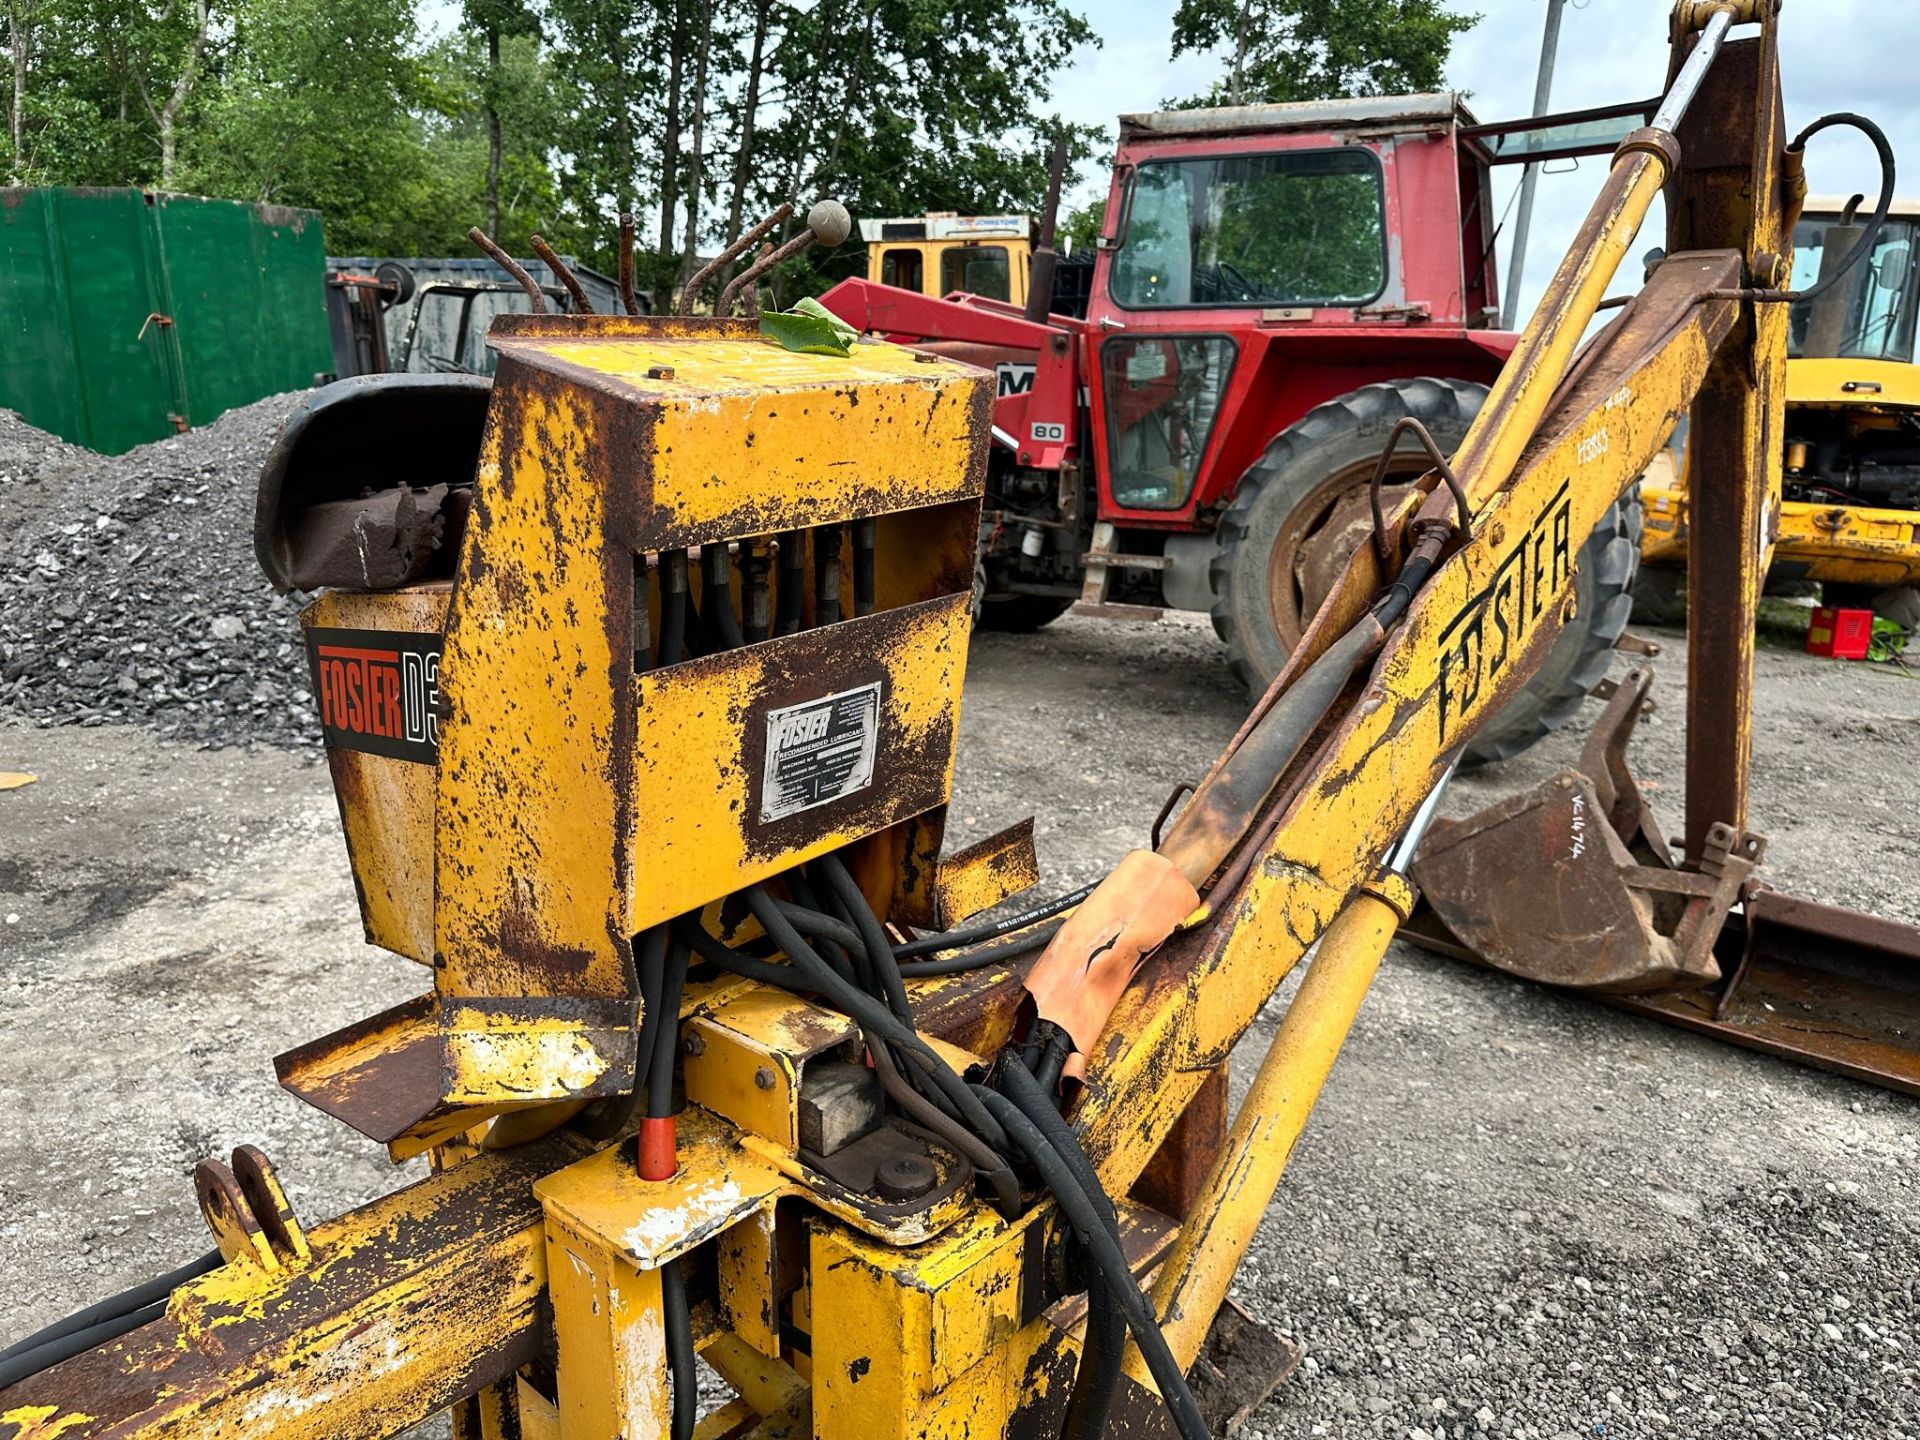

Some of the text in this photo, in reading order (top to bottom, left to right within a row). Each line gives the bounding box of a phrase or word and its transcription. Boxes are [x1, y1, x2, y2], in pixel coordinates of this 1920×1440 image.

[1034, 425, 1062, 439] 80
[1437, 477, 1571, 748] FOSTER
[318, 645, 403, 740] FOSTER
[779, 706, 833, 750] FOSTER
[780, 739, 829, 759] RECOMMENDED
